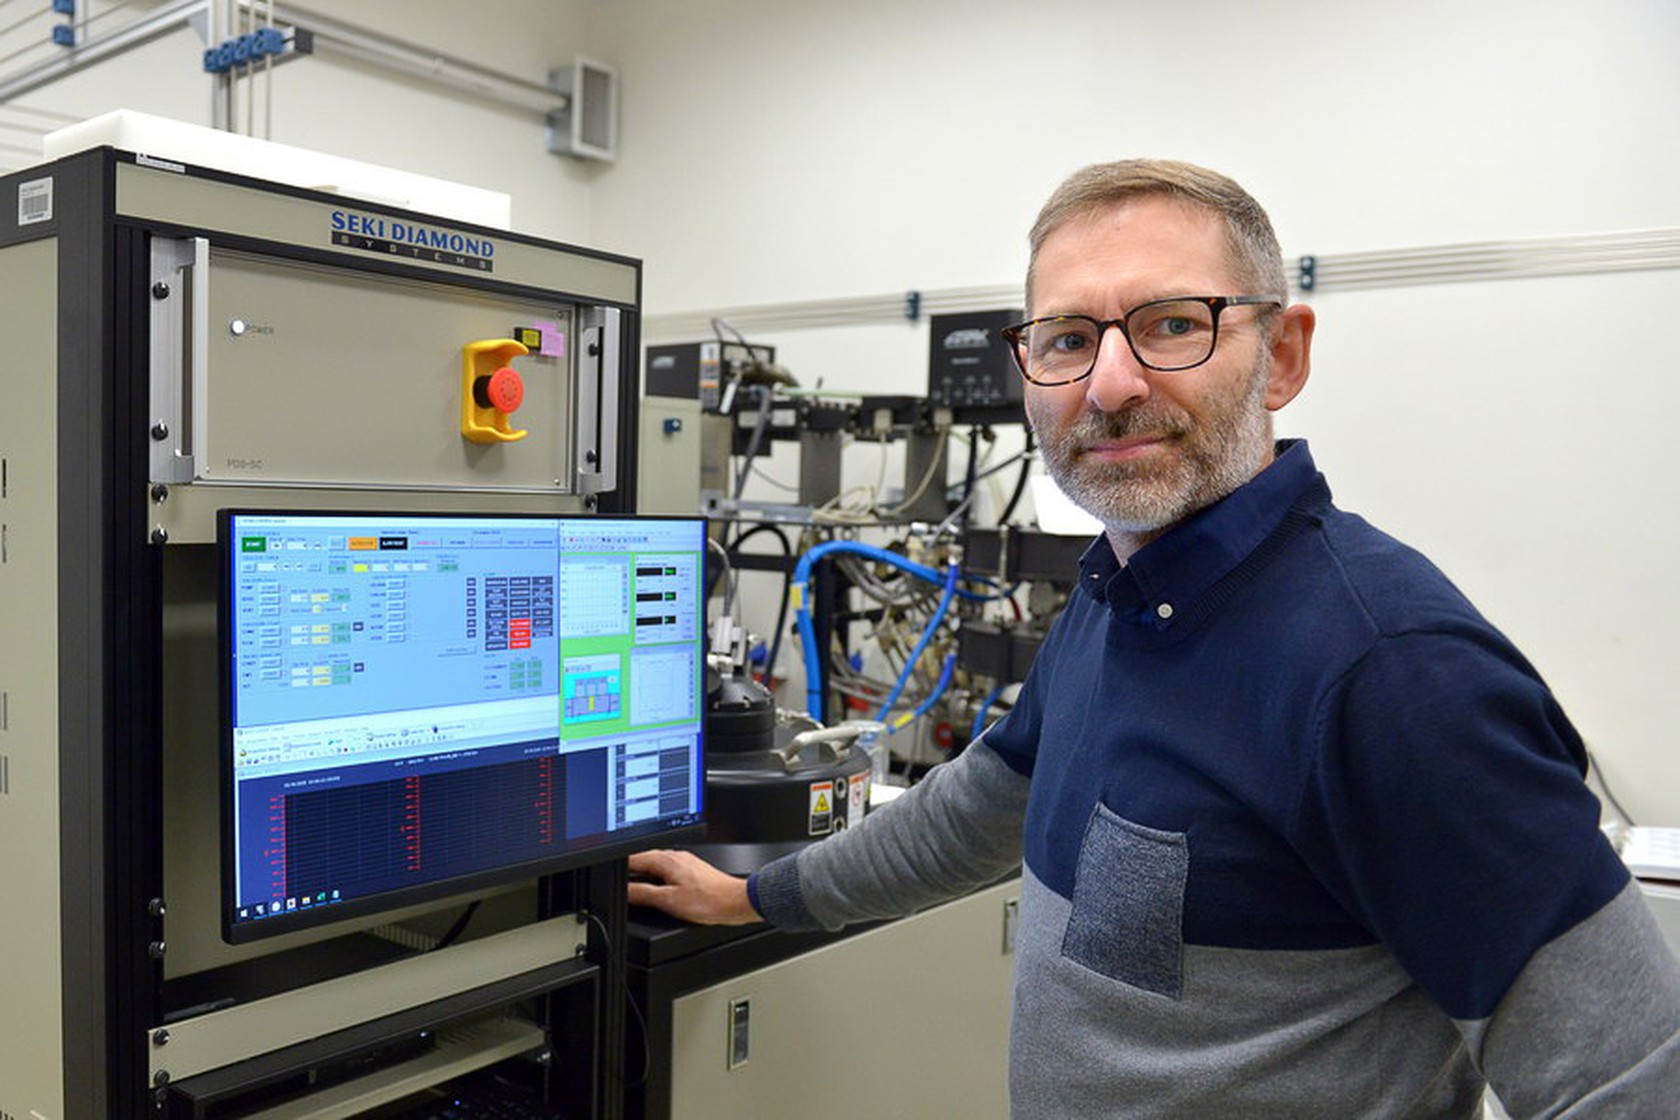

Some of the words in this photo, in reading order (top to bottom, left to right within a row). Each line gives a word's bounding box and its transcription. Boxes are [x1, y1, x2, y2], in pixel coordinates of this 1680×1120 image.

[331, 211, 384, 238] SEKI
[391, 223, 494, 257] DIAMOND
[340, 235, 487, 270] SYSTEMS
